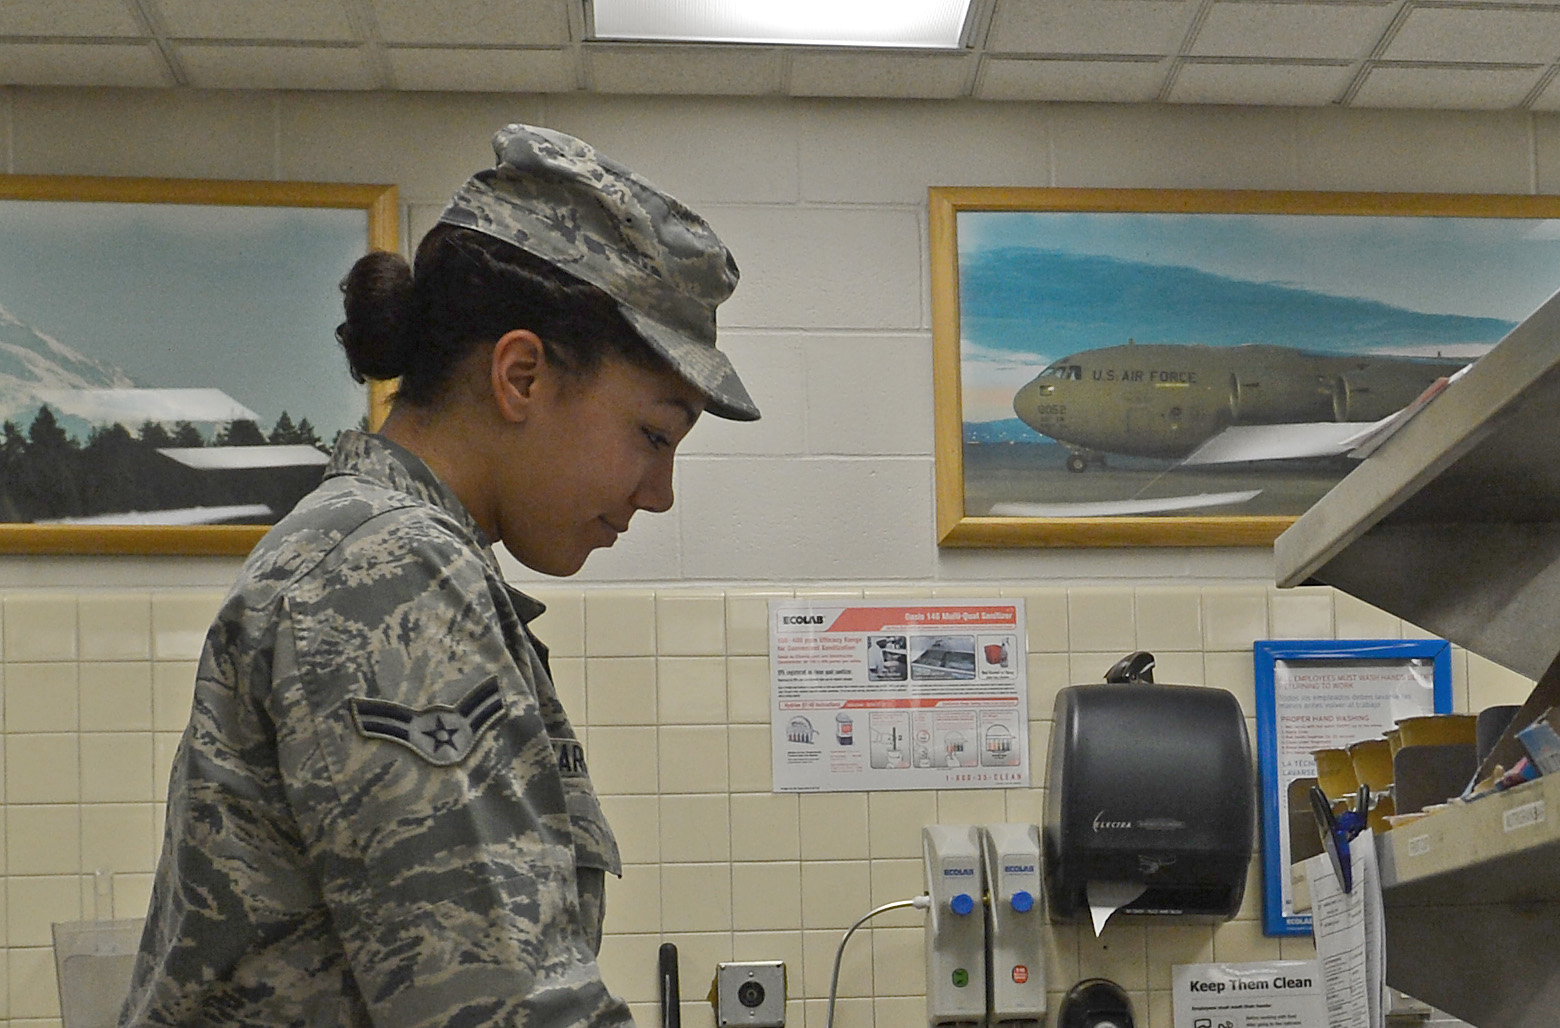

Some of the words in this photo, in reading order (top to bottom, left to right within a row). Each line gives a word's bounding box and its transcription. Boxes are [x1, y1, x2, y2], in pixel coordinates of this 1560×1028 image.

[1121, 370, 1144, 382] AIR
[1150, 371, 1197, 384] FORCE
[783, 615, 824, 625] ECOLAB
[1189, 980, 1226, 994] Keep
[1229, 978, 1269, 991] Them
[1273, 976, 1312, 989] Clean
